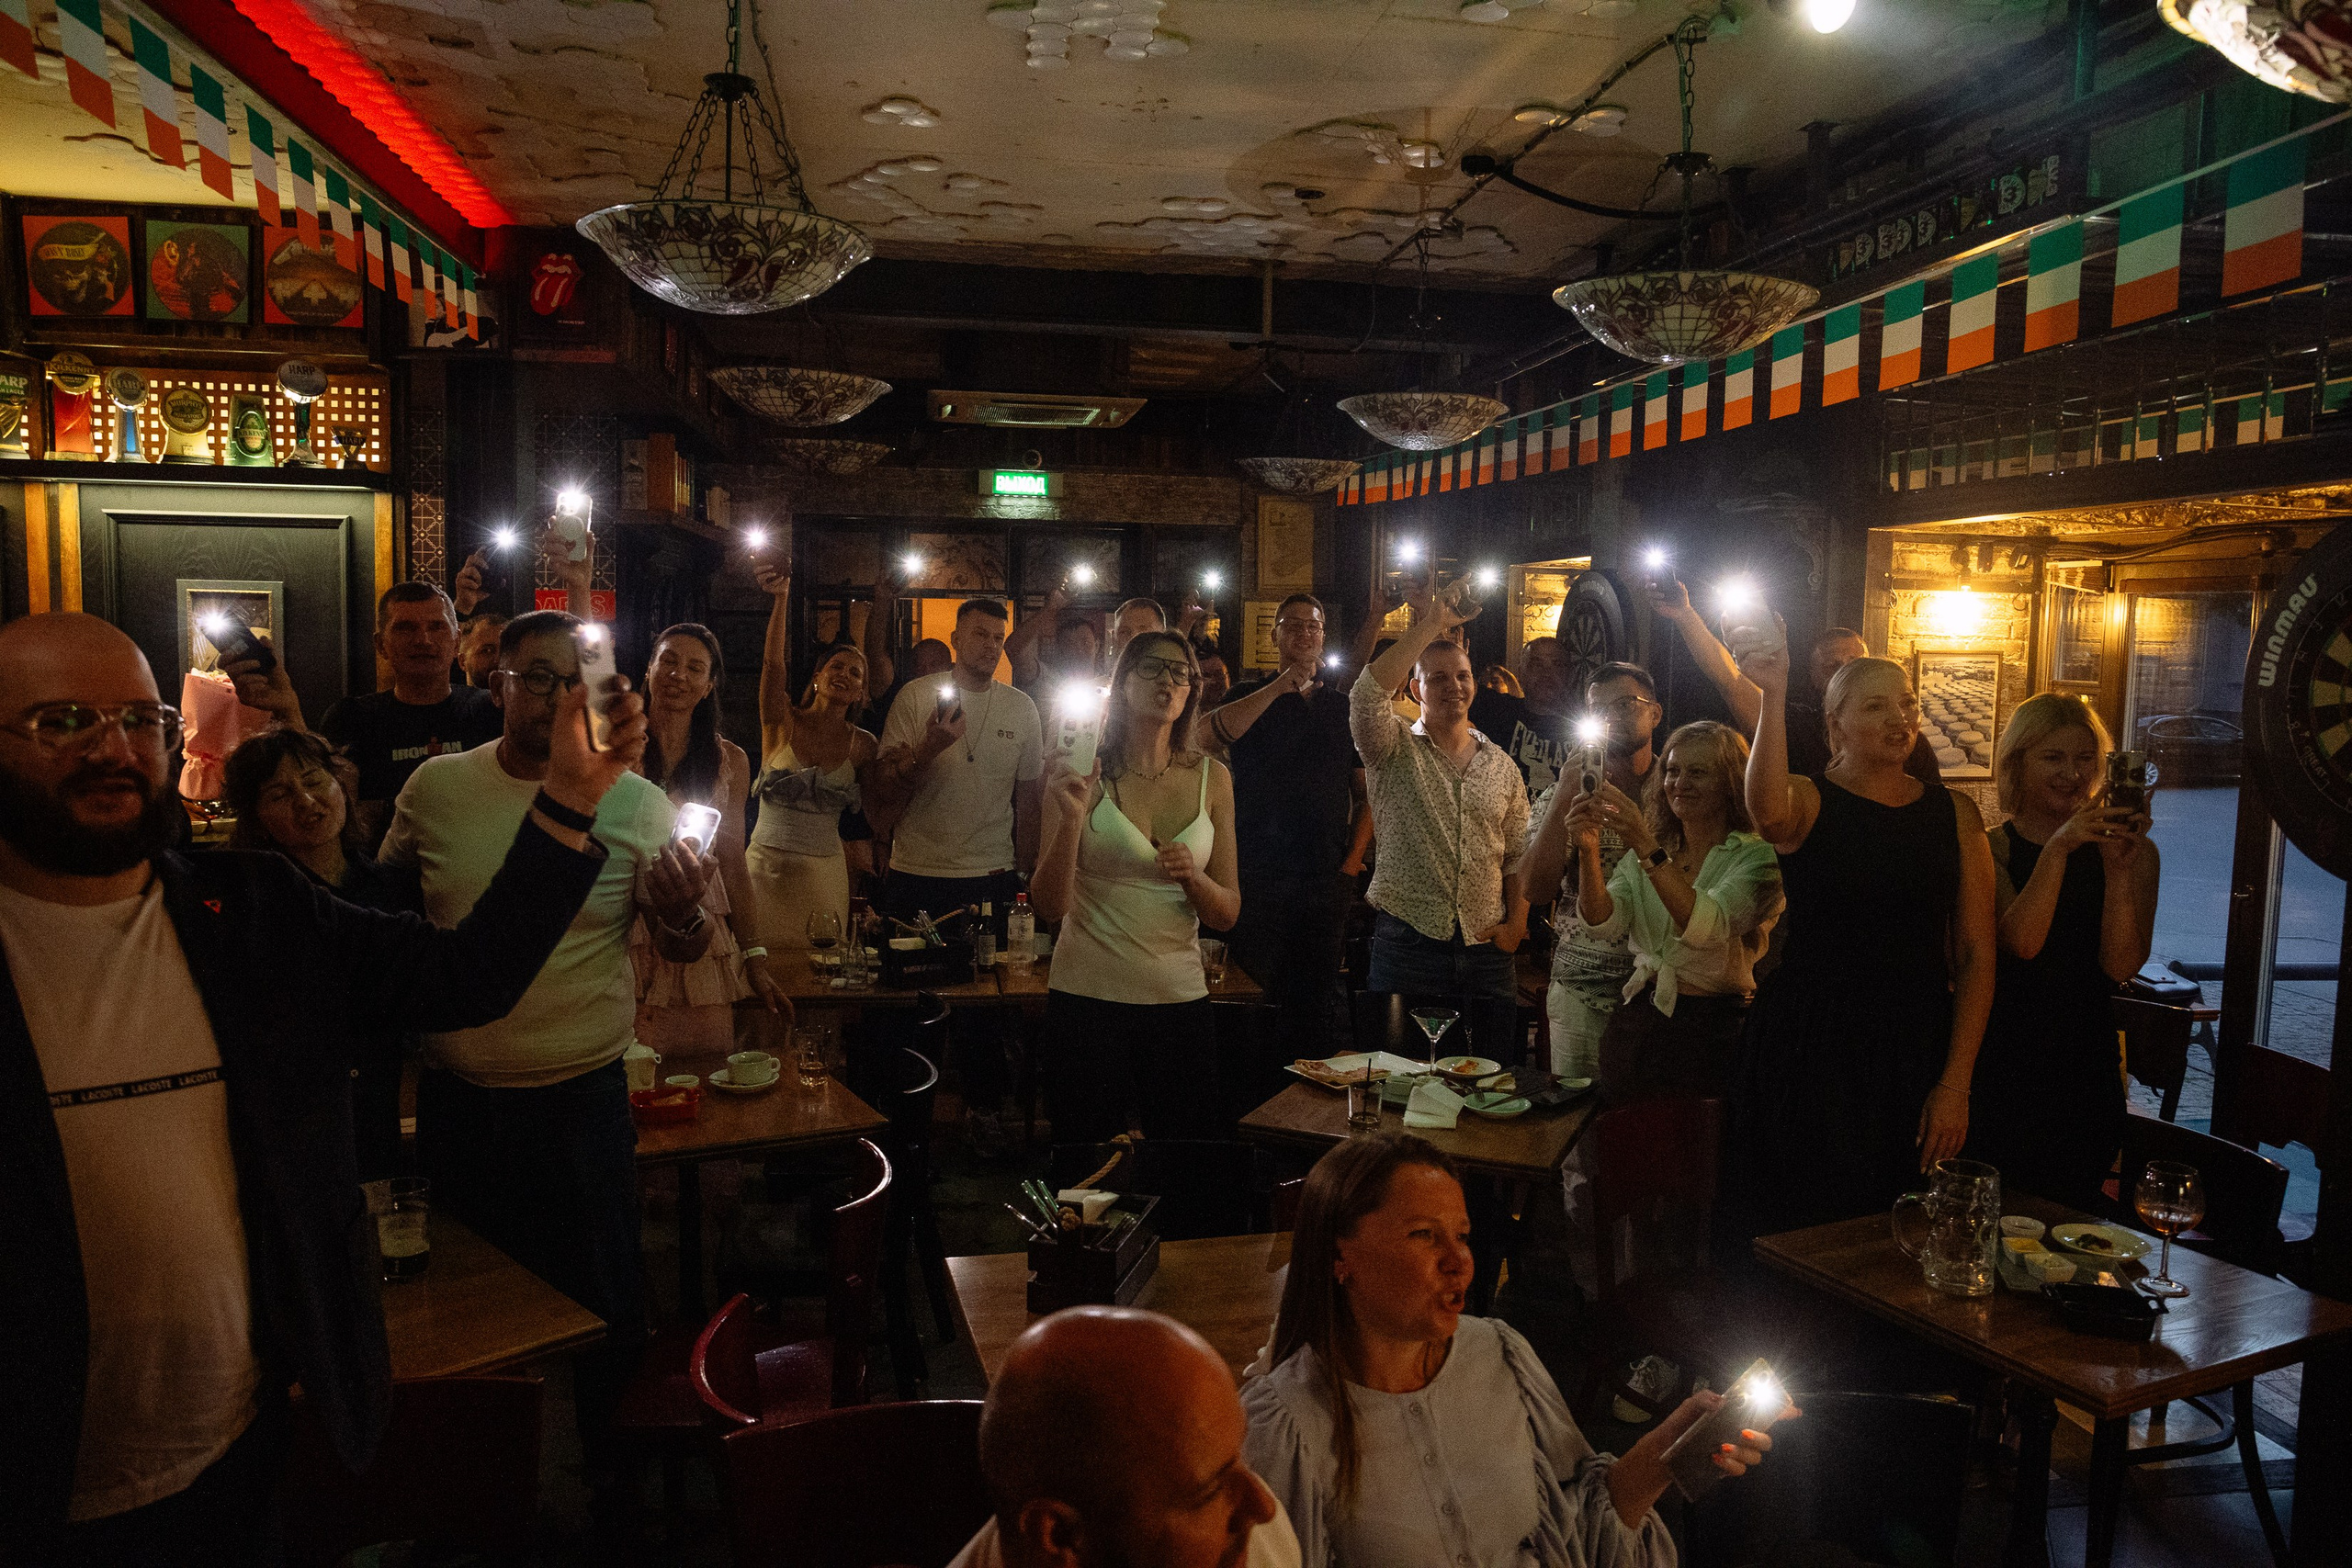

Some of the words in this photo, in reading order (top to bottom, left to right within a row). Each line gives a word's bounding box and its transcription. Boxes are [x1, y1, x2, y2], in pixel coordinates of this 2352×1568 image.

[49, 362, 96, 374] KILKENNY
[288, 364, 315, 376] HARP
[0, 374, 28, 389] ARP
[995, 475, 1046, 494] ВЫХОД
[2257, 574, 2318, 687] WINMAU
[81, 1086, 125, 1102] LACOSTE
[130, 1078, 173, 1094] LACOSTE
[178, 1070, 218, 1087] LACOSTE
